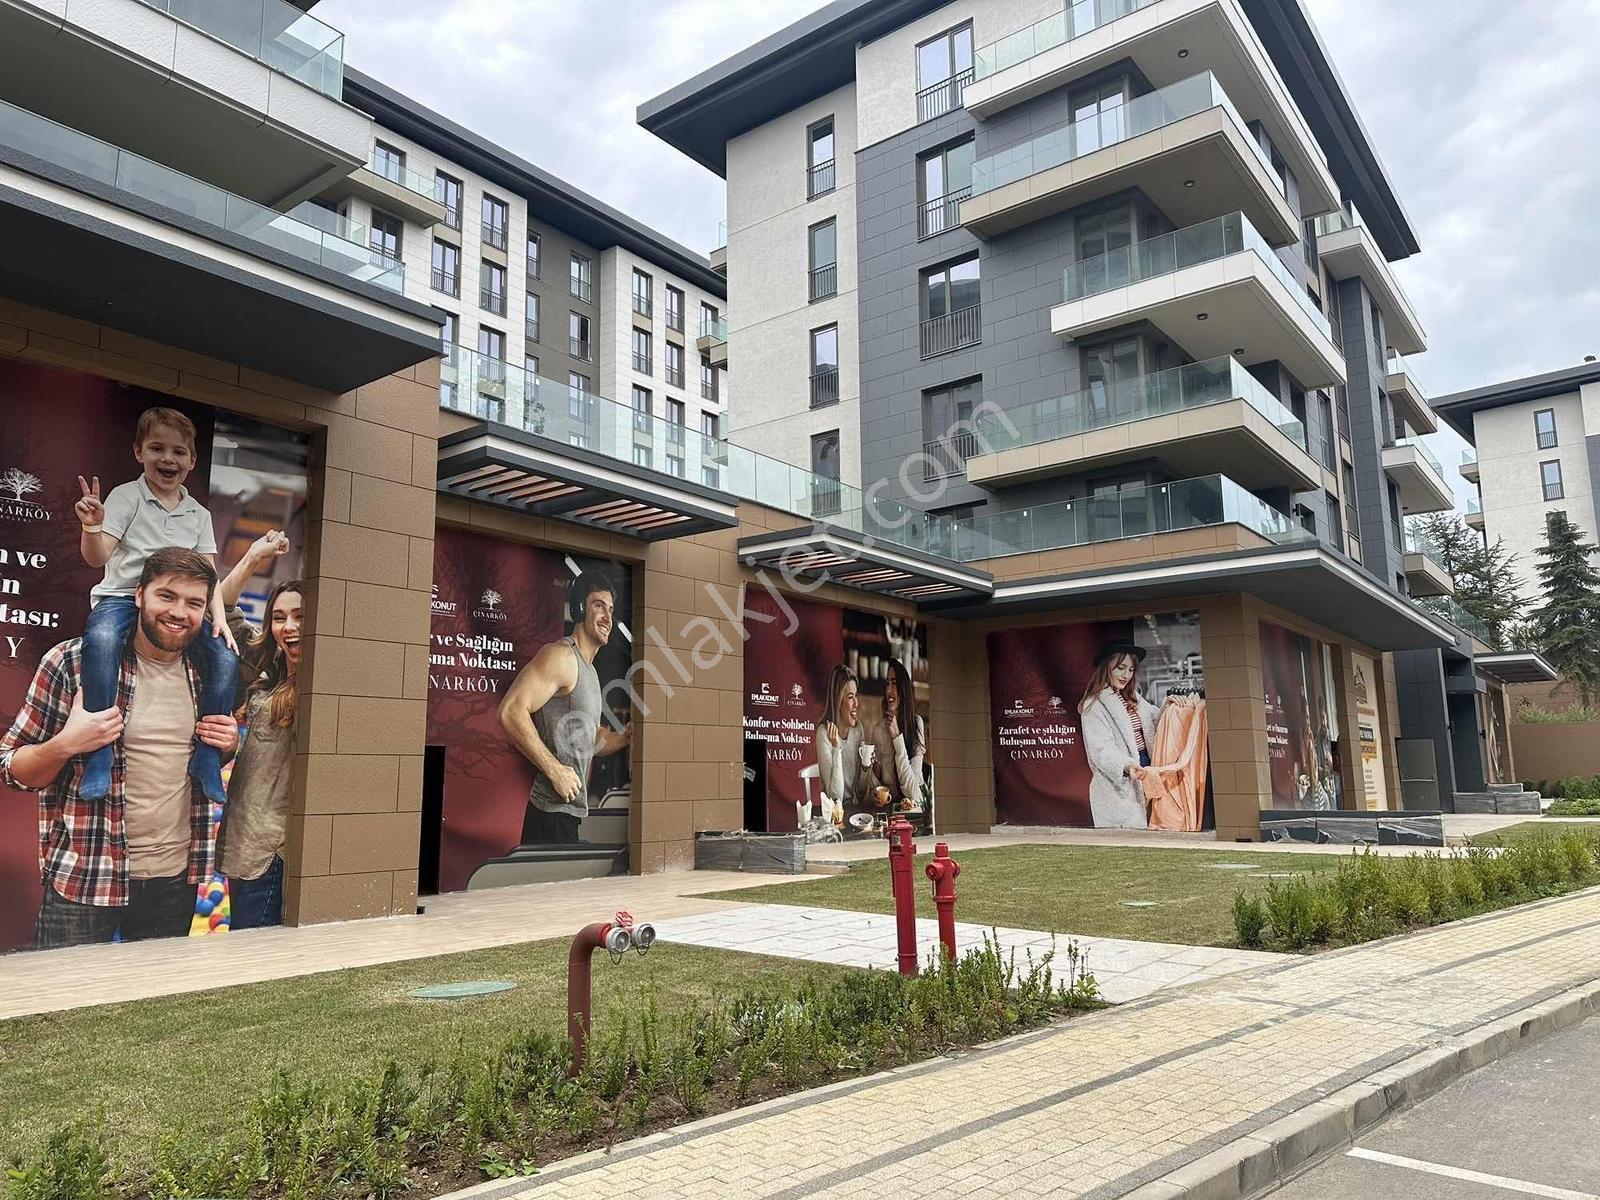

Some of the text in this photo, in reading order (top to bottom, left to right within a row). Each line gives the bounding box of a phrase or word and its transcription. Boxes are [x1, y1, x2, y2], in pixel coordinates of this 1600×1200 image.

[16, 551, 47, 569] ve
[0, 572, 21, 594] n
[0, 603, 59, 628] tası:
[5, 636, 26, 658] Y
[436, 633, 514, 655] ve Sağlığın
[458, 652, 517, 671] Noktası:
[743, 715, 815, 731] Konfor ve Sohbetin
[998, 726, 1030, 735] Zarafet
[780, 732, 811, 744] Noktası:
[1000, 735, 1075, 748] Buluşma Noktası:
[1010, 748, 1064, 760] ÇINARKÖY
